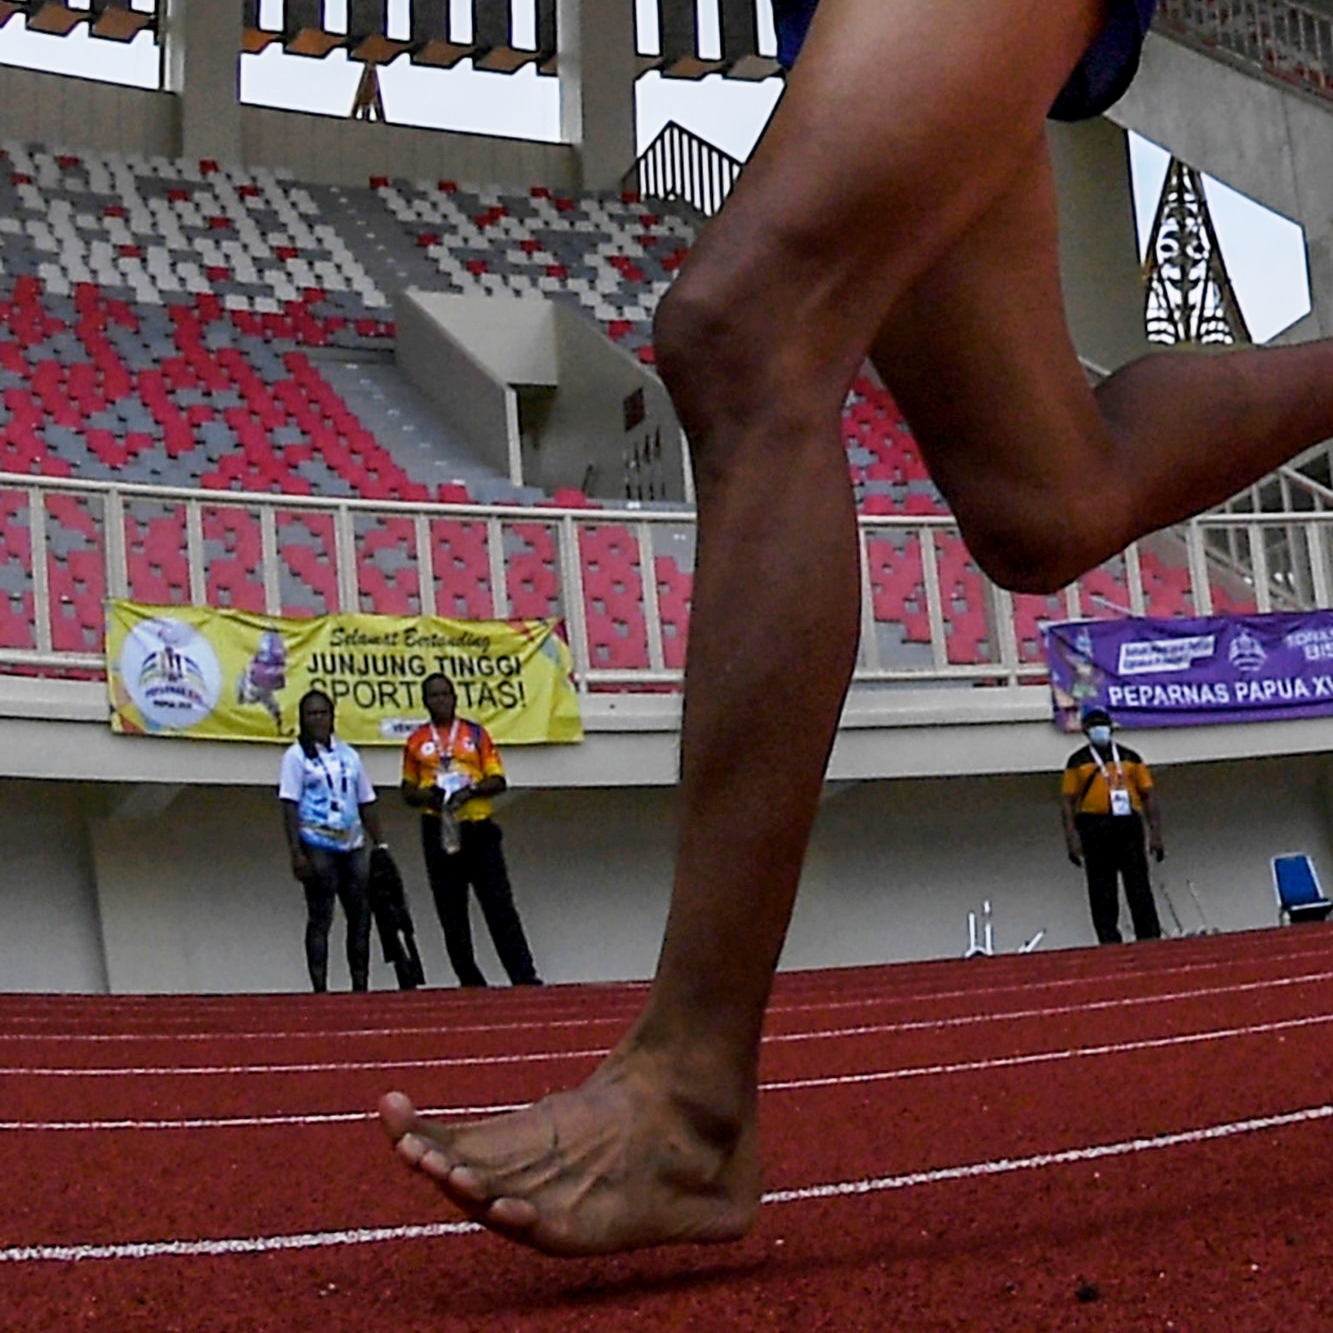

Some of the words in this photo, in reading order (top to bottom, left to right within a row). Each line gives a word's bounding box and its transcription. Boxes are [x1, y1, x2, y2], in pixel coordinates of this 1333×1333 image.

[330, 626, 399, 648] Selamat
[402, 626, 491, 652] Bertanding
[307, 653, 426, 677] JUNJUNG
[433, 654, 522, 677] TINGGI
[1108, 682, 1230, 707] PEPARNAS
[1235, 680, 1309, 702] PAPUA
